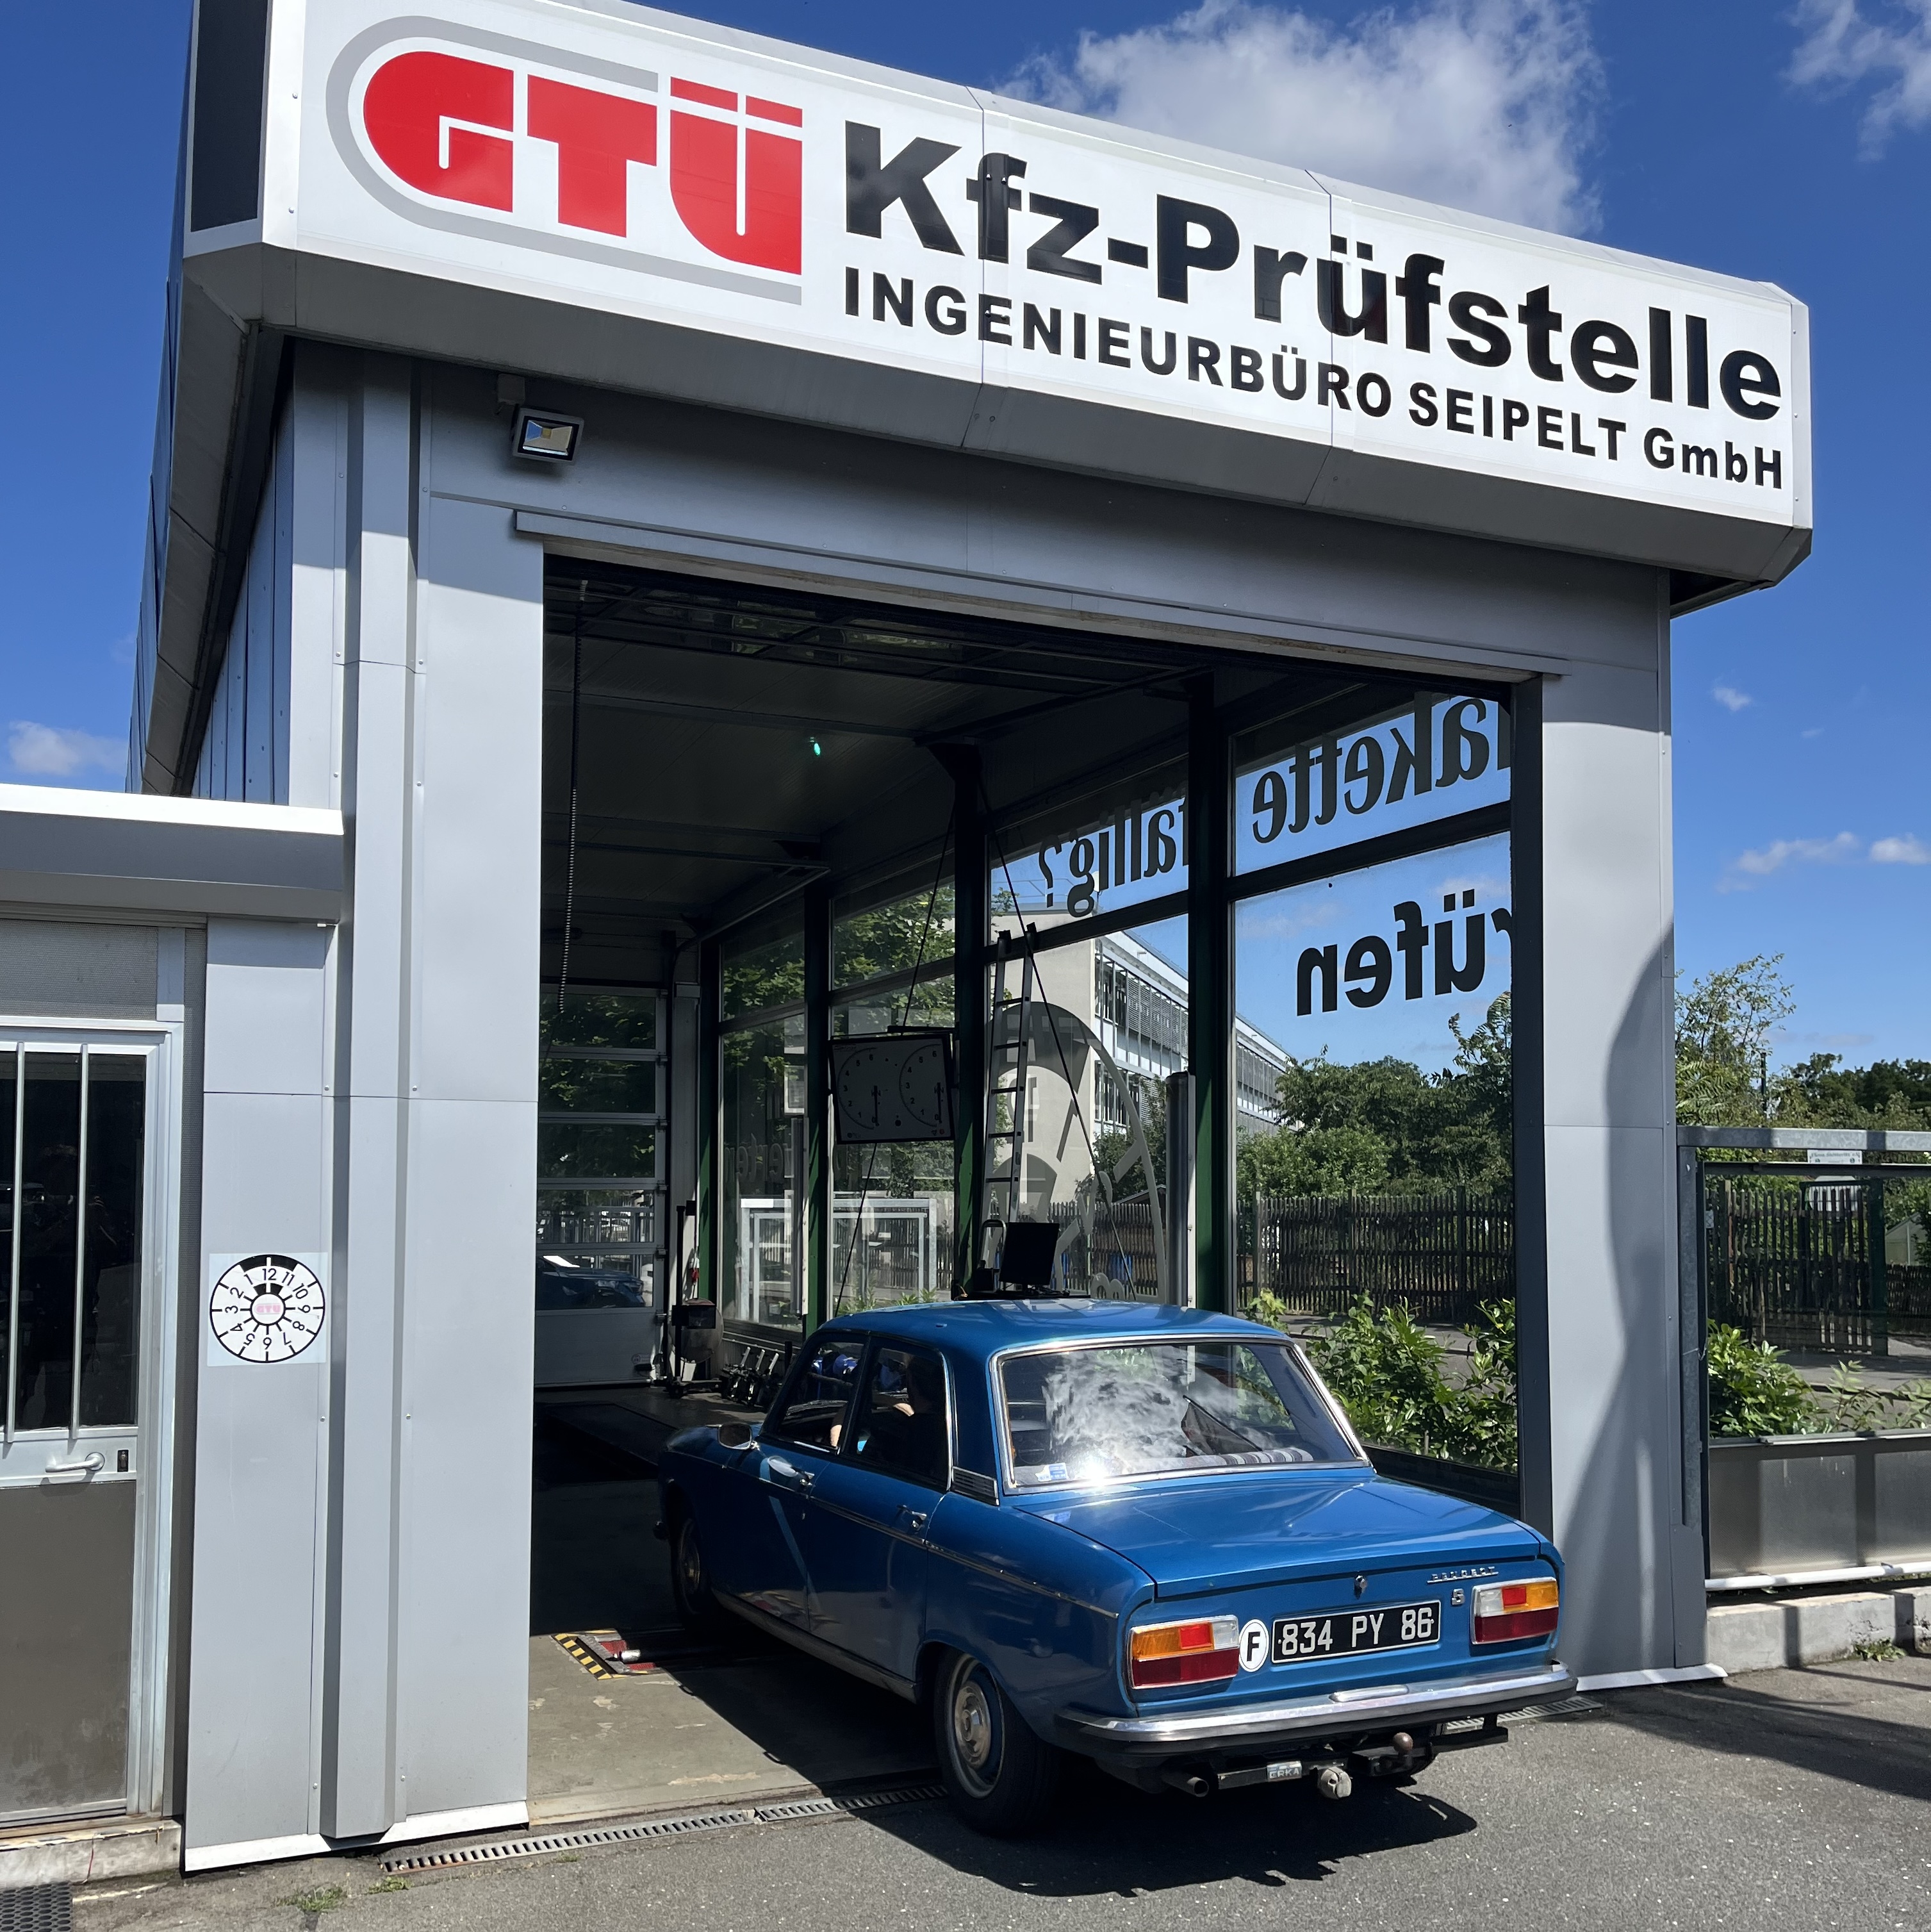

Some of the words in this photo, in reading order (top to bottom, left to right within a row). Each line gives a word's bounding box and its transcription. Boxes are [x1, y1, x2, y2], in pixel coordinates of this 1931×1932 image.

[363, 51, 802, 275] GTÜ
[845, 120, 1781, 420] Kfz-Prüfstelle
[845, 267, 1392, 418] INGENIEURBÜRO
[1409, 383, 1627, 461] SEIPELT
[1644, 427, 1782, 490] GmbH
[243, 1273, 254, 1285] 1
[261, 1267, 277, 1281] 12
[281, 1271, 295, 1286] 11
[229, 1287, 244, 1299] 2
[292, 1283, 309, 1300] 10
[224, 1305, 239, 1314] 3
[297, 1304, 311, 1314] 9
[229, 1322, 243, 1332] 4
[292, 1320, 306, 1332] 8
[243, 1333, 256, 1346] 5
[262, 1337, 272, 1351] 6
[282, 1332, 292, 1346] 7
[1281, 1619, 1333, 1655] 834
[1351, 1613, 1385, 1649] PY
[1401, 1606, 1433, 1641] 86
[1245, 1630, 1261, 1663] F
